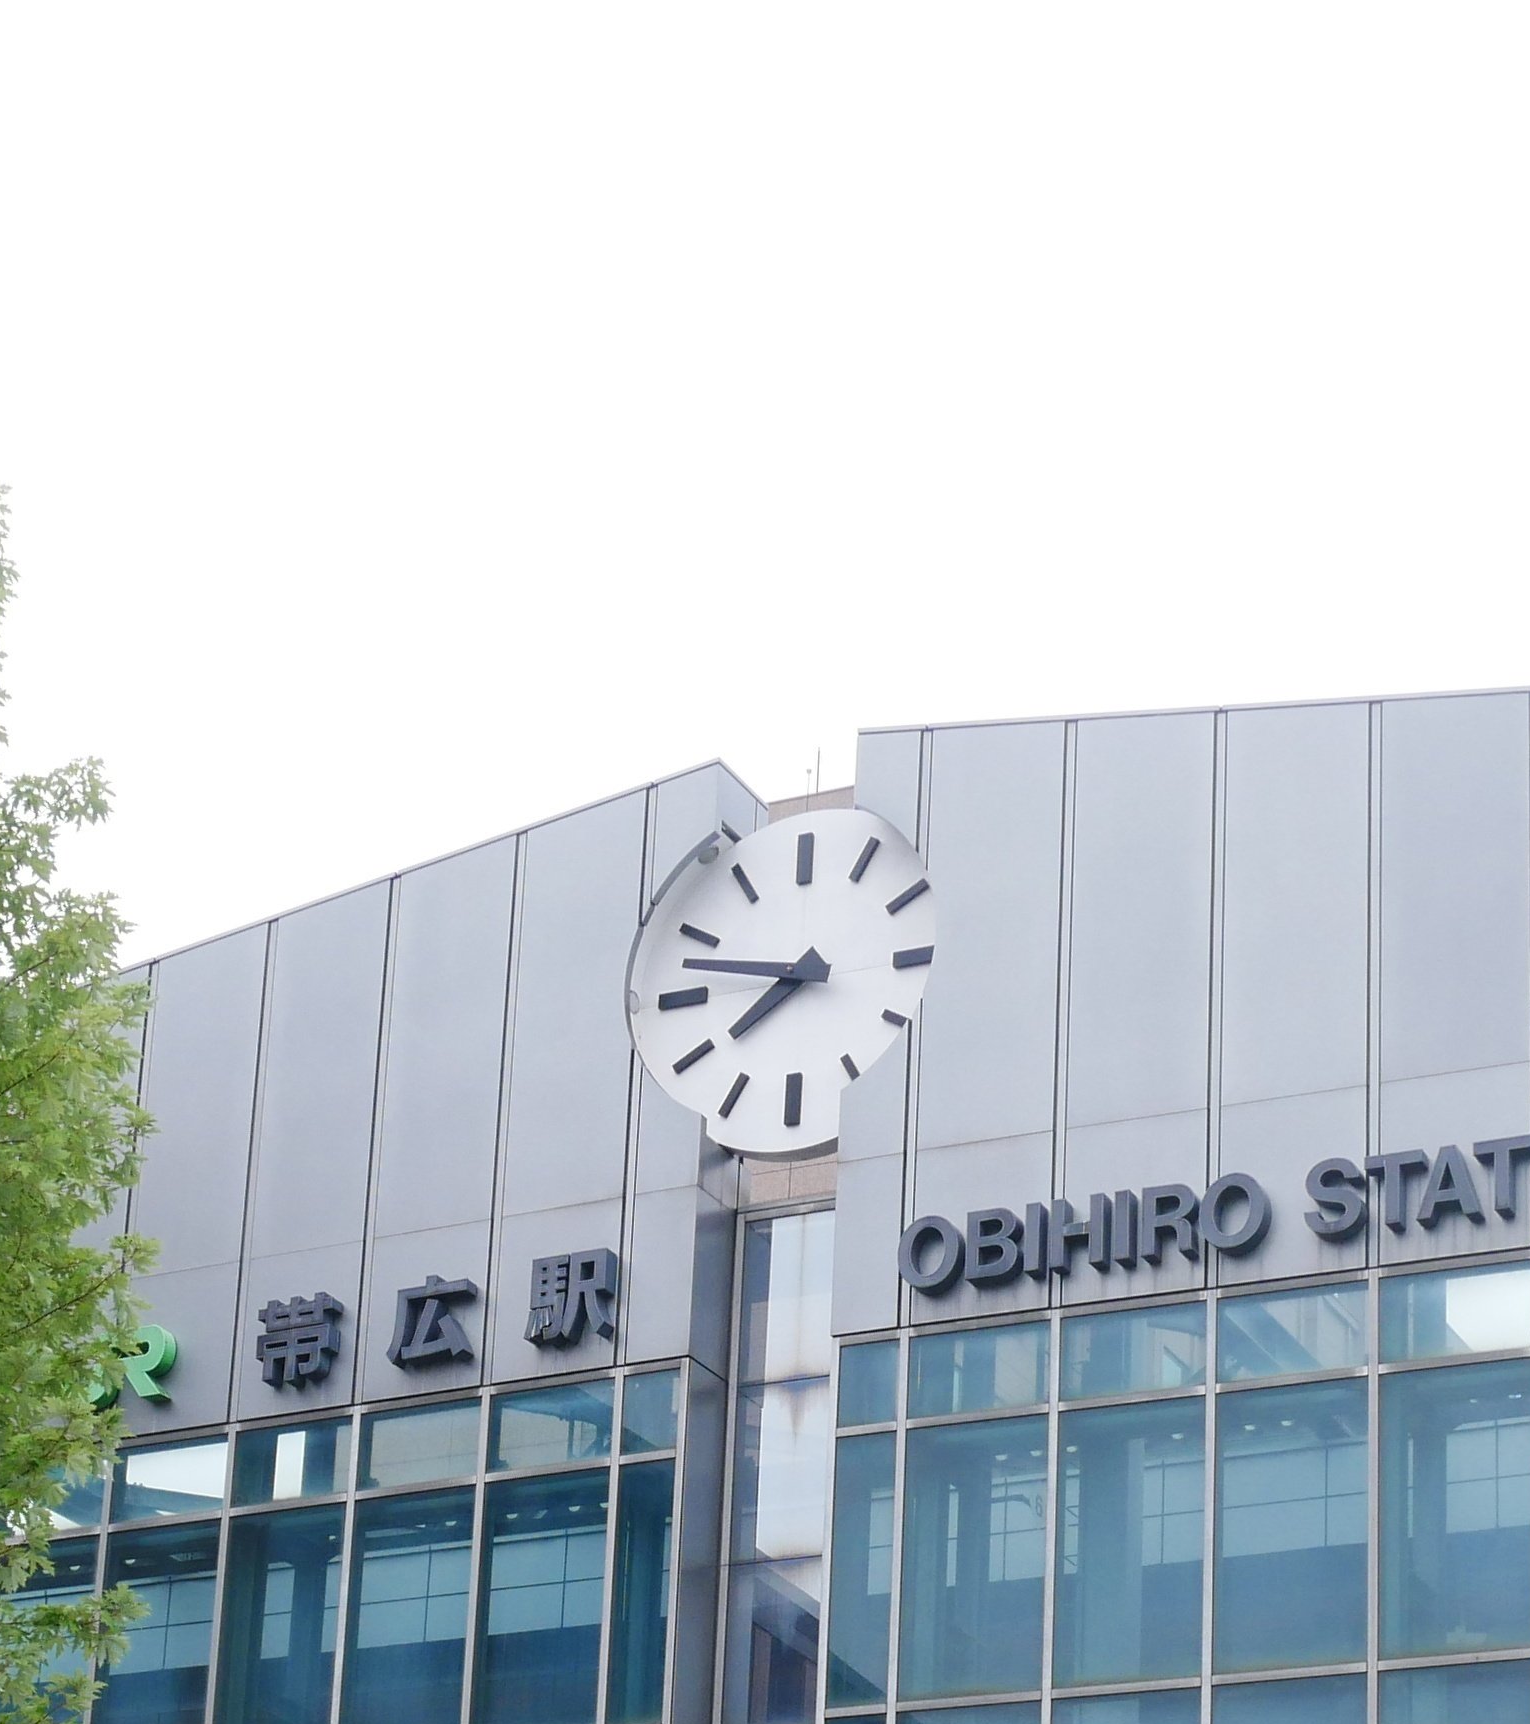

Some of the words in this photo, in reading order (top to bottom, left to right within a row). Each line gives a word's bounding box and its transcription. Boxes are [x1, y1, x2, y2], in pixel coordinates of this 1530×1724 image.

[897, 1172, 1271, 1295] OBIHIRO
[255, 1247, 619, 1390] 帯広駅
